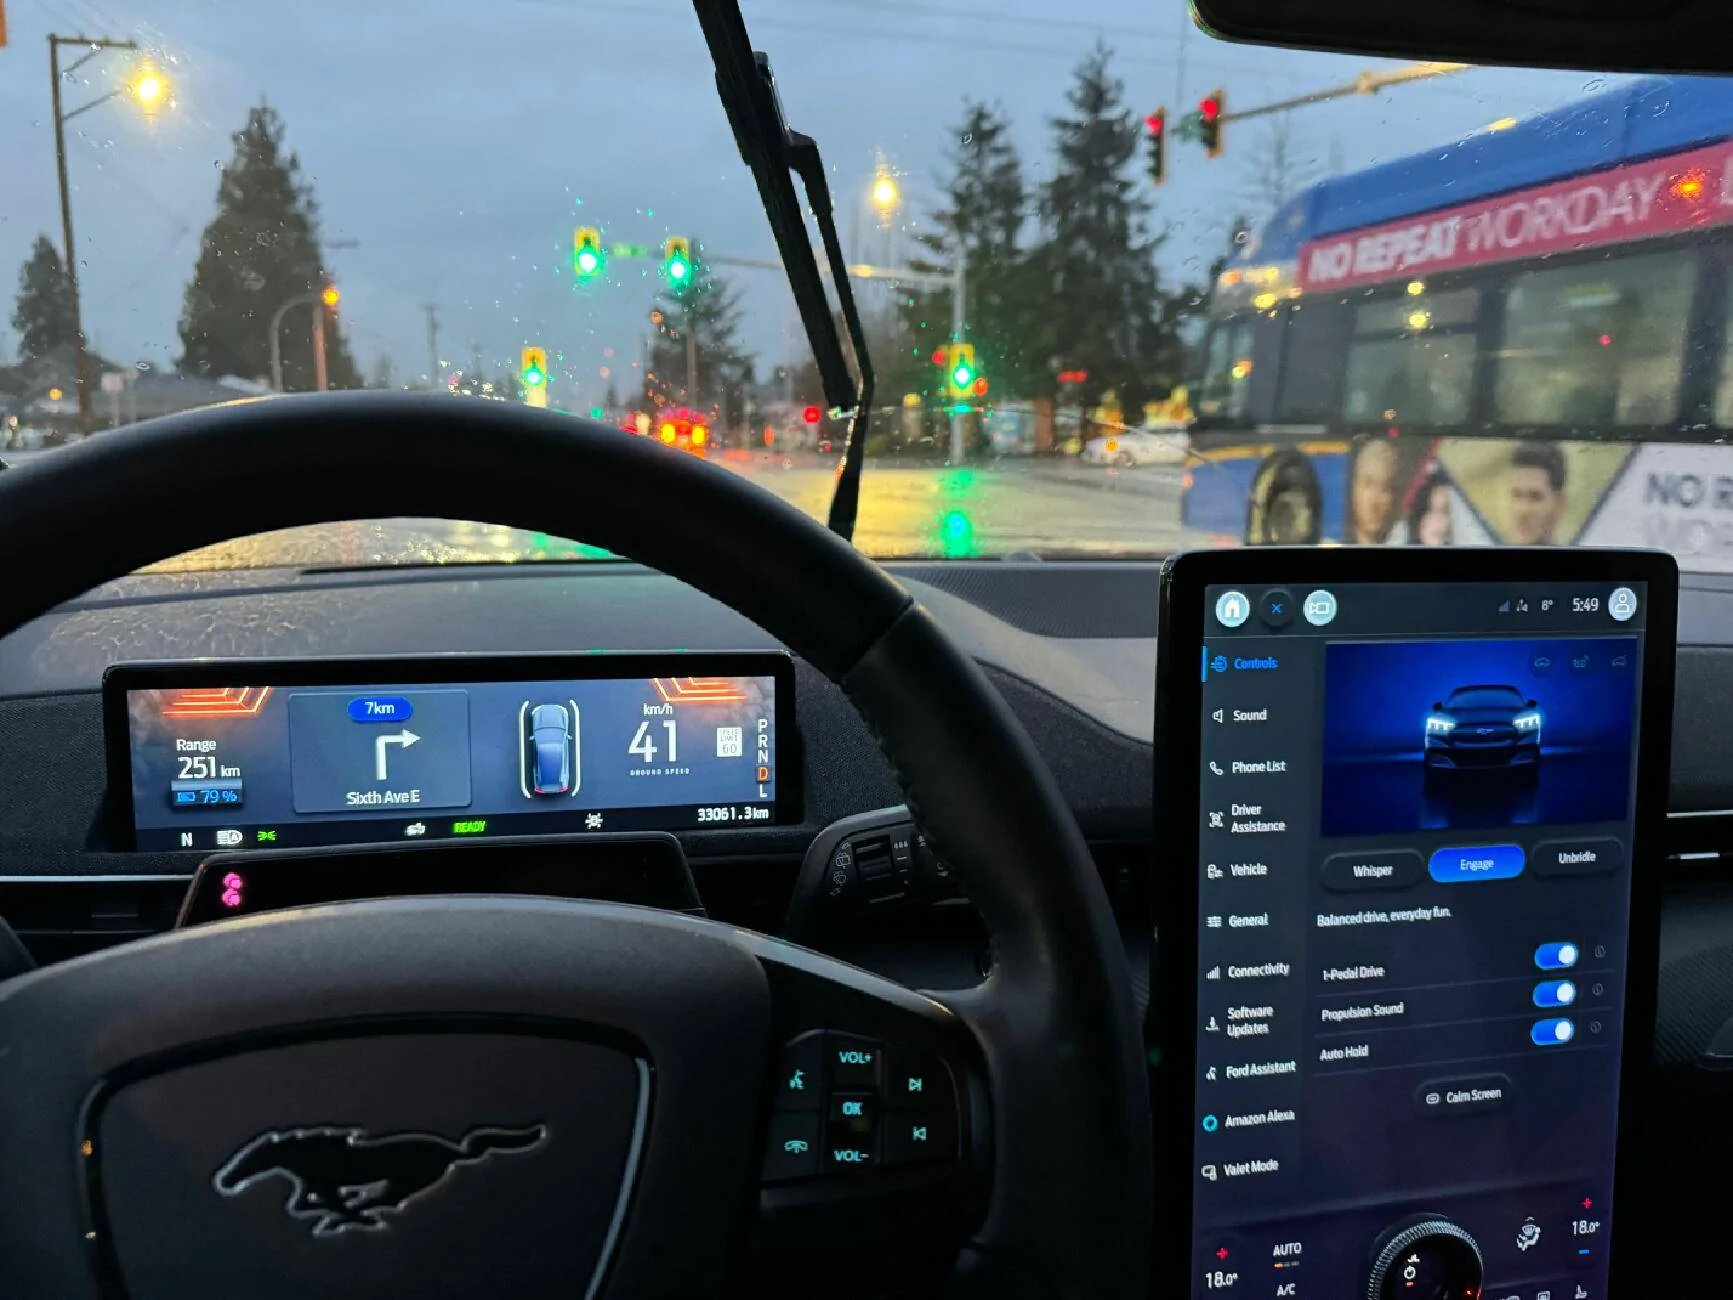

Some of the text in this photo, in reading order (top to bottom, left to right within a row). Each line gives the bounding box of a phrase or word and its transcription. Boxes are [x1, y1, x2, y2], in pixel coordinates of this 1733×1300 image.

[1308, 242, 1355, 283] NO
[1354, 216, 1464, 275] REPEAT
[1463, 172, 1667, 252] WORKDAY
[1645, 473, 1705, 508] NO
[1572, 598, 1599, 612] 5:49
[1233, 656, 1279, 671] Controls
[364, 701, 395, 716] 7km
[643, 703, 672, 716] km/h
[1233, 707, 1268, 722] Sound
[176, 739, 217, 752] Range
[628, 720, 677, 763] 41
[722, 744, 738, 754] 60
[758, 719, 768, 798] P R N D L
[177, 756, 240, 779] 251 km
[1232, 760, 1287, 774] Phone List
[201, 790, 238, 804] 79 %
[346, 790, 420, 805] Sixth Ave E
[1231, 804, 1262, 817] Driver
[453, 821, 486, 833] READY
[1231, 820, 1286, 834] Assistance
[181, 832, 193, 847] N
[1558, 851, 1596, 864] Unbridle
[1231, 863, 1268, 877] Vehicle
[1353, 864, 1394, 878] Whisper
[1460, 859, 1494, 872] Engage
[1229, 912, 1269, 928] General
[1317, 906, 1452, 927] Balanced drive, everyday fun.
[1228, 963, 1290, 978] Connectivity
[1323, 966, 1386, 981] 1-Pedal Drive
[1228, 1005, 1274, 1020] Software
[1322, 1002, 1405, 1022] Propulsion Sound
[1227, 1023, 1269, 1039] Updates
[839, 1051, 873, 1064] VOL+
[1320, 1045, 1369, 1061] Auto Hold
[1226, 1060, 1297, 1079] Ford Assistant
[1447, 1088, 1502, 1104] Calm Screen
[842, 1102, 863, 1116] OK
[1224, 1110, 1296, 1128] Amazon Alexa
[1224, 1159, 1279, 1177] Valet Mode
[1273, 1242, 1302, 1257] AUTO
[1276, 1283, 1296, 1296] A/C
